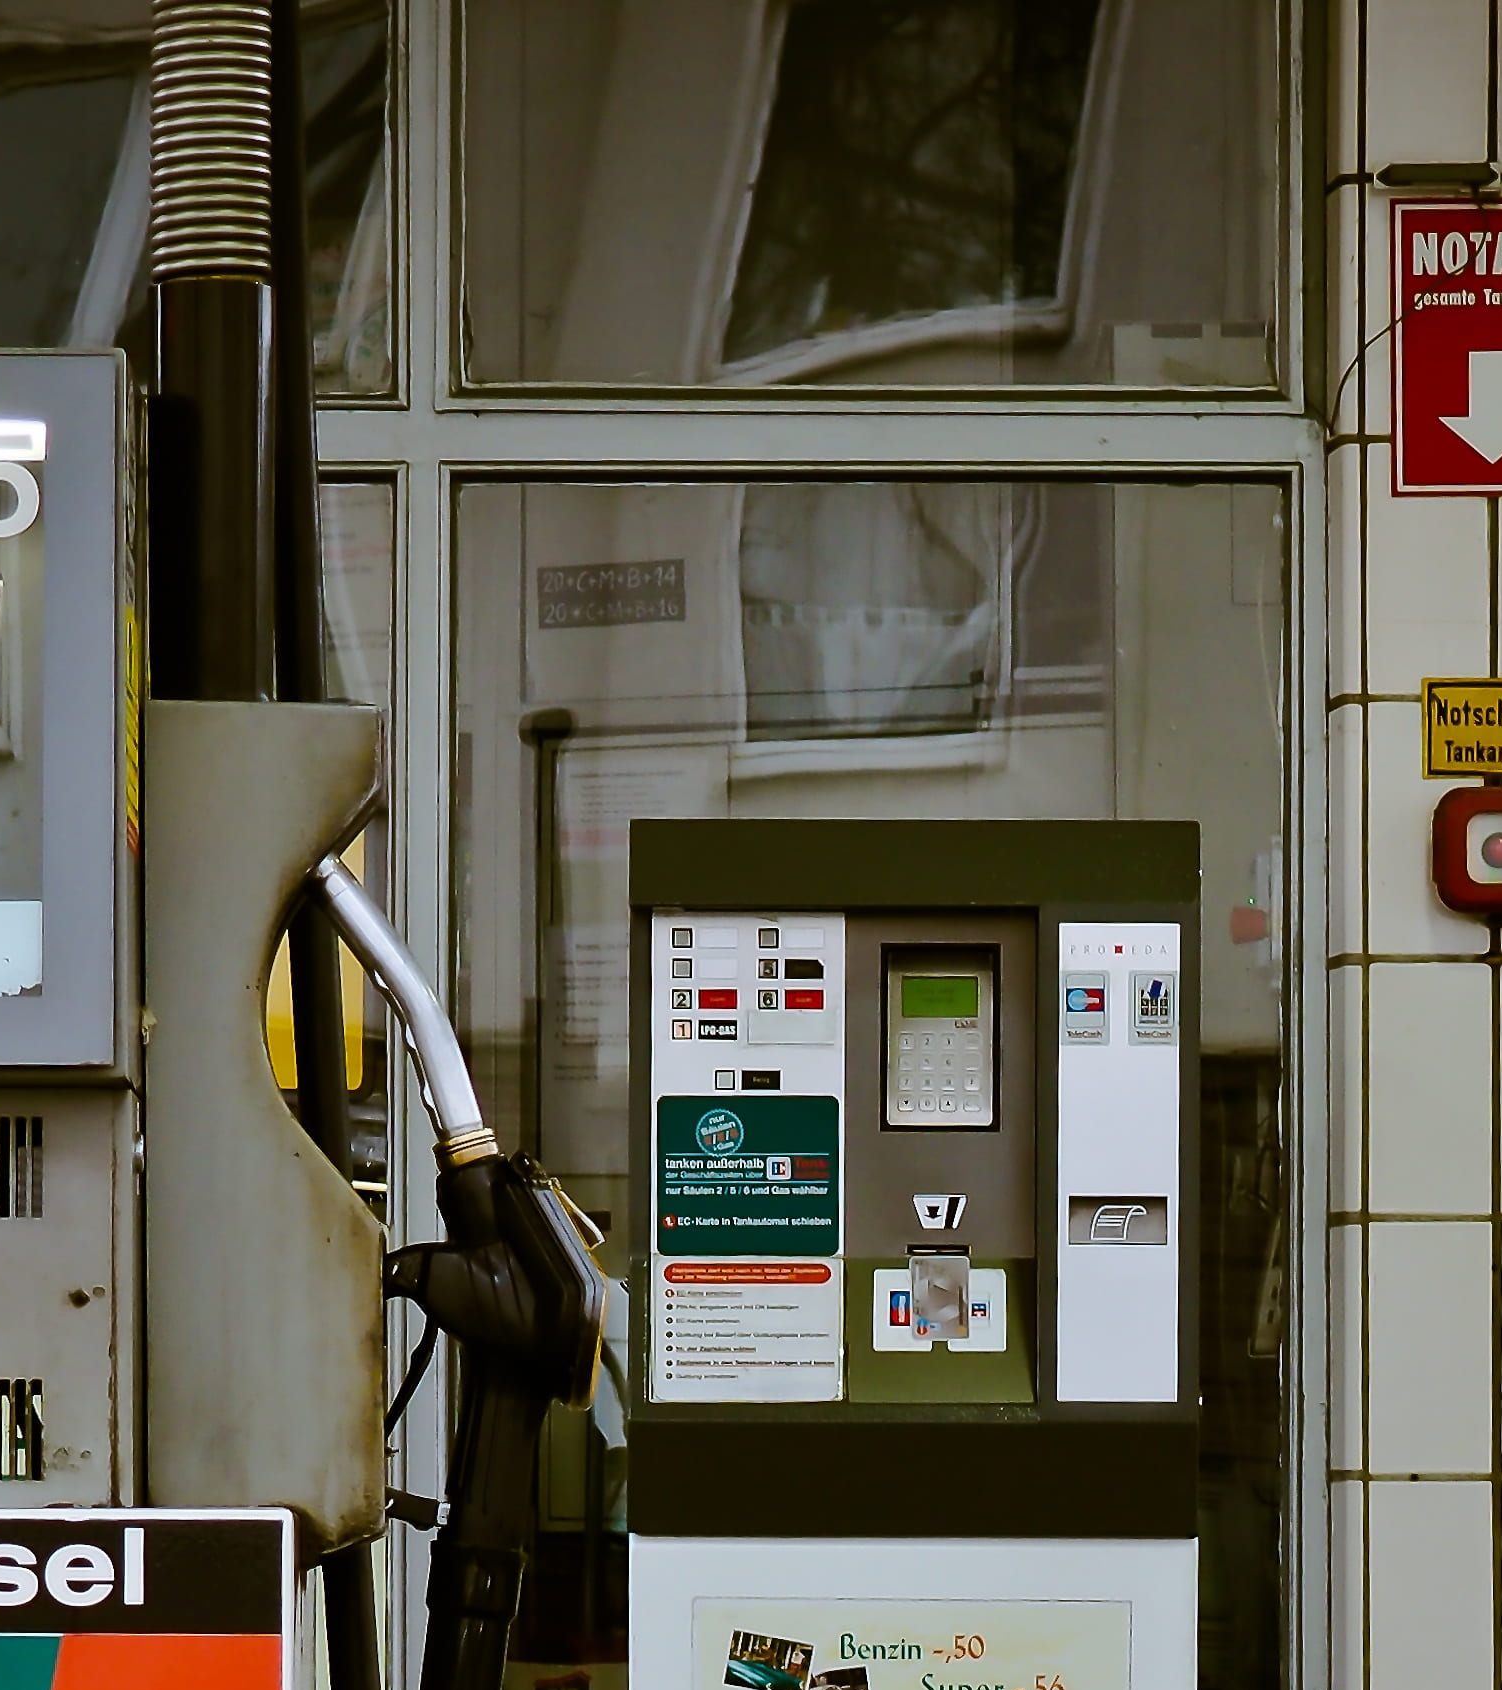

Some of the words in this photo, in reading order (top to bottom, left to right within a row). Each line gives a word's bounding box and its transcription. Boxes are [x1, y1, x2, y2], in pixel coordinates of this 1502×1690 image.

[1416, 291, 1476, 310] gesamte
[675, 991, 688, 1007] 2
[762, 991, 774, 1007] 6
[665, 1158, 704, 1170] tanken
[841, 1633, 923, 1661] Benzin
